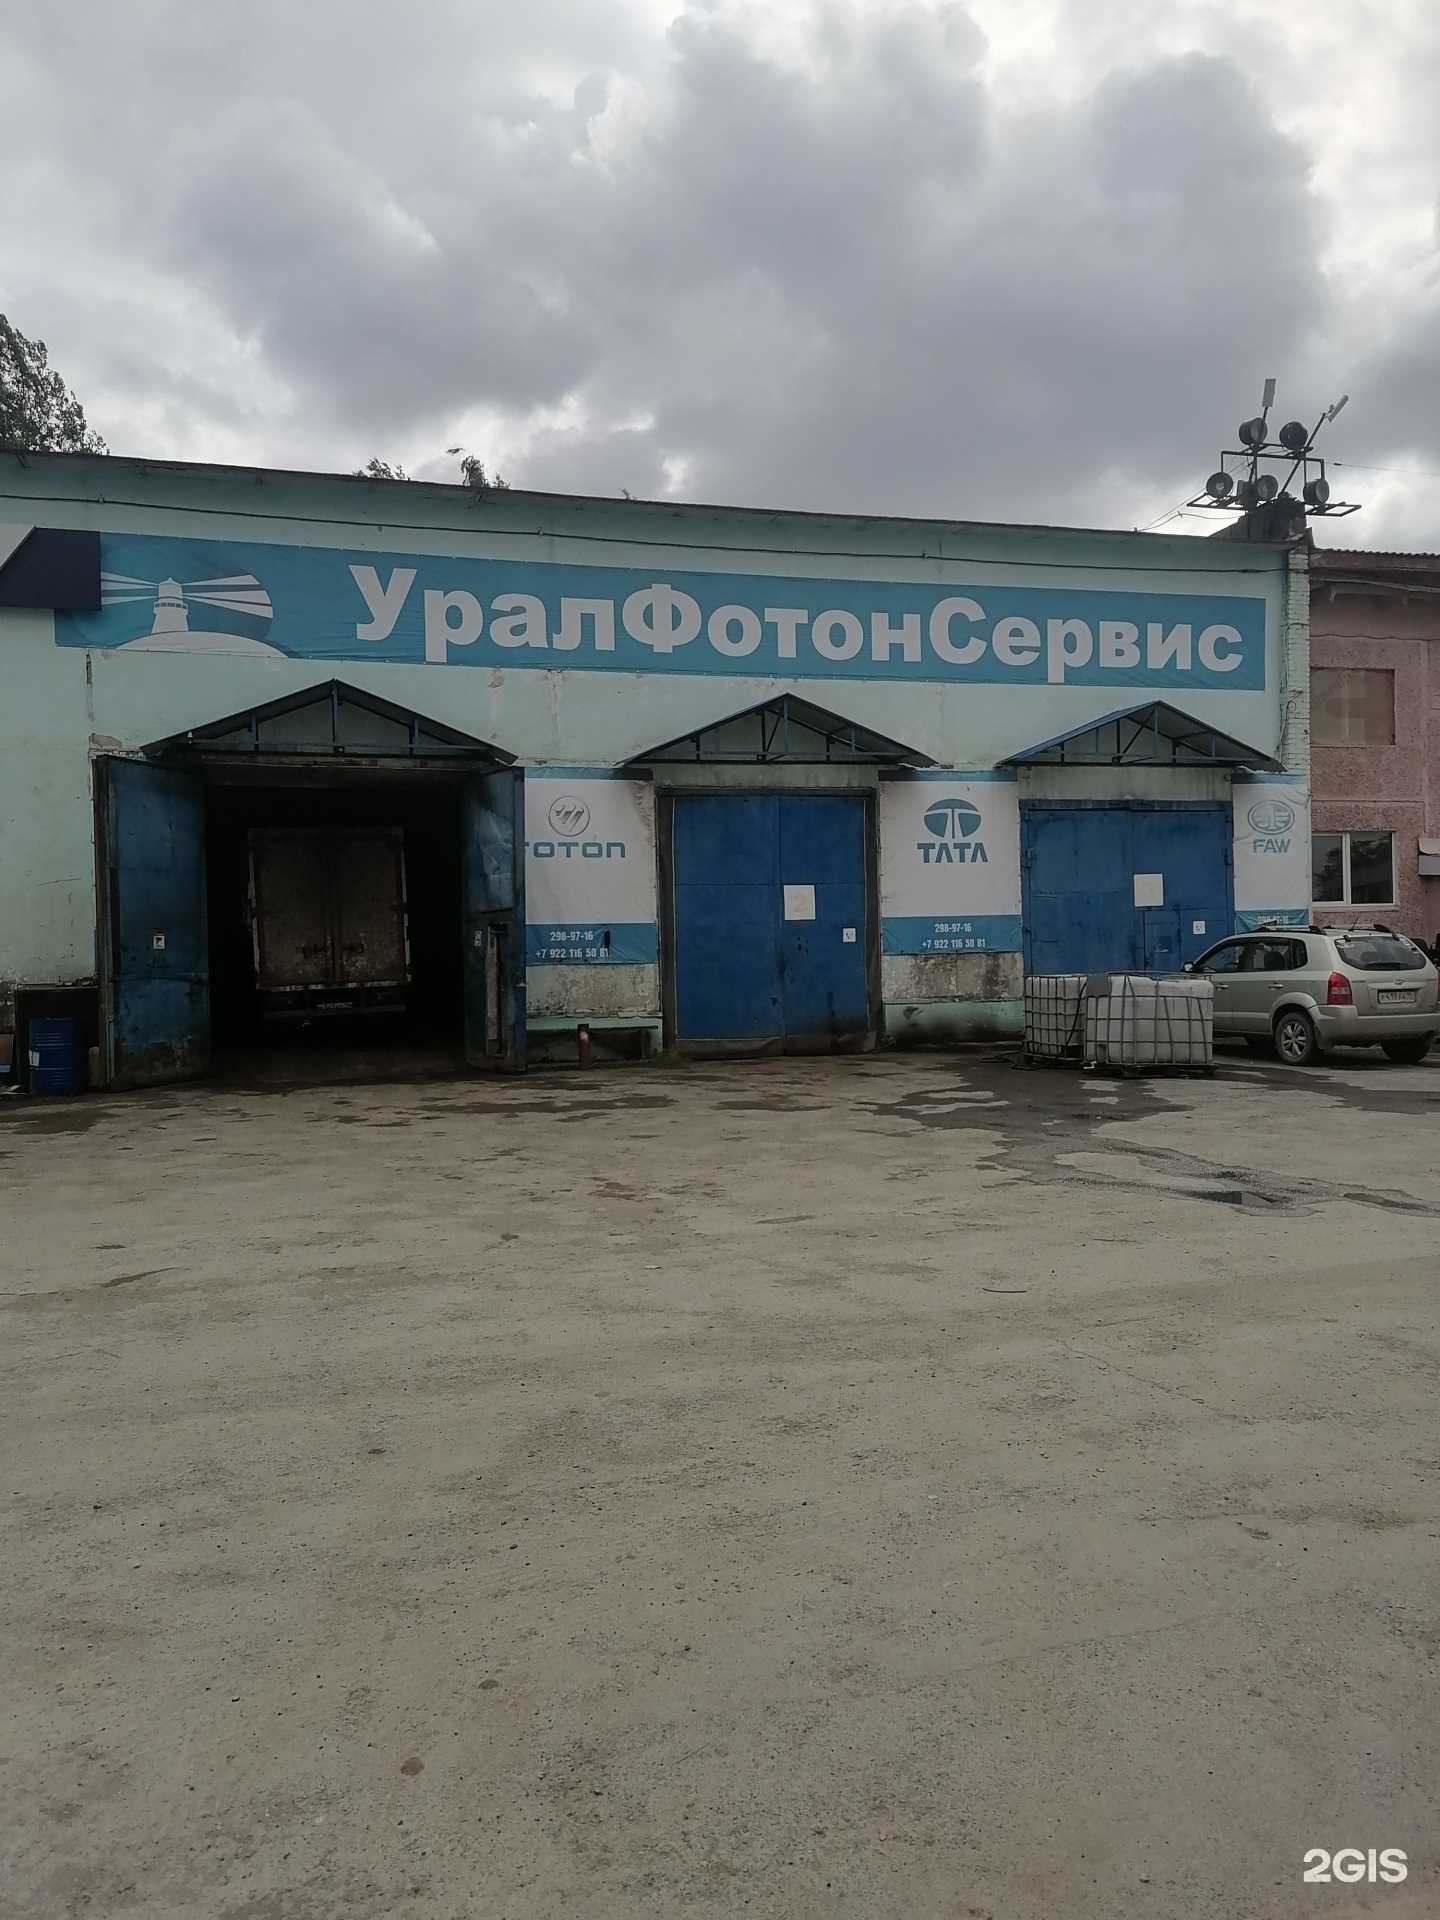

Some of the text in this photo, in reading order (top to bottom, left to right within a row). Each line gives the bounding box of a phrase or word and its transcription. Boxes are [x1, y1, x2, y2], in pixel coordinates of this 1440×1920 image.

[347, 564, 1244, 684] УралФотонСервис
[524, 841, 626, 859] OTON
[917, 842, 989, 864] TATA
[1253, 838, 1291, 854] FAW
[549, 930, 594, 942] 298-97-16
[934, 939, 949, 949] 922
[535, 948, 547, 959] +7
[549, 948, 567, 958] 922
[569, 948, 583, 958] 116
[585, 947, 597, 958] 50
